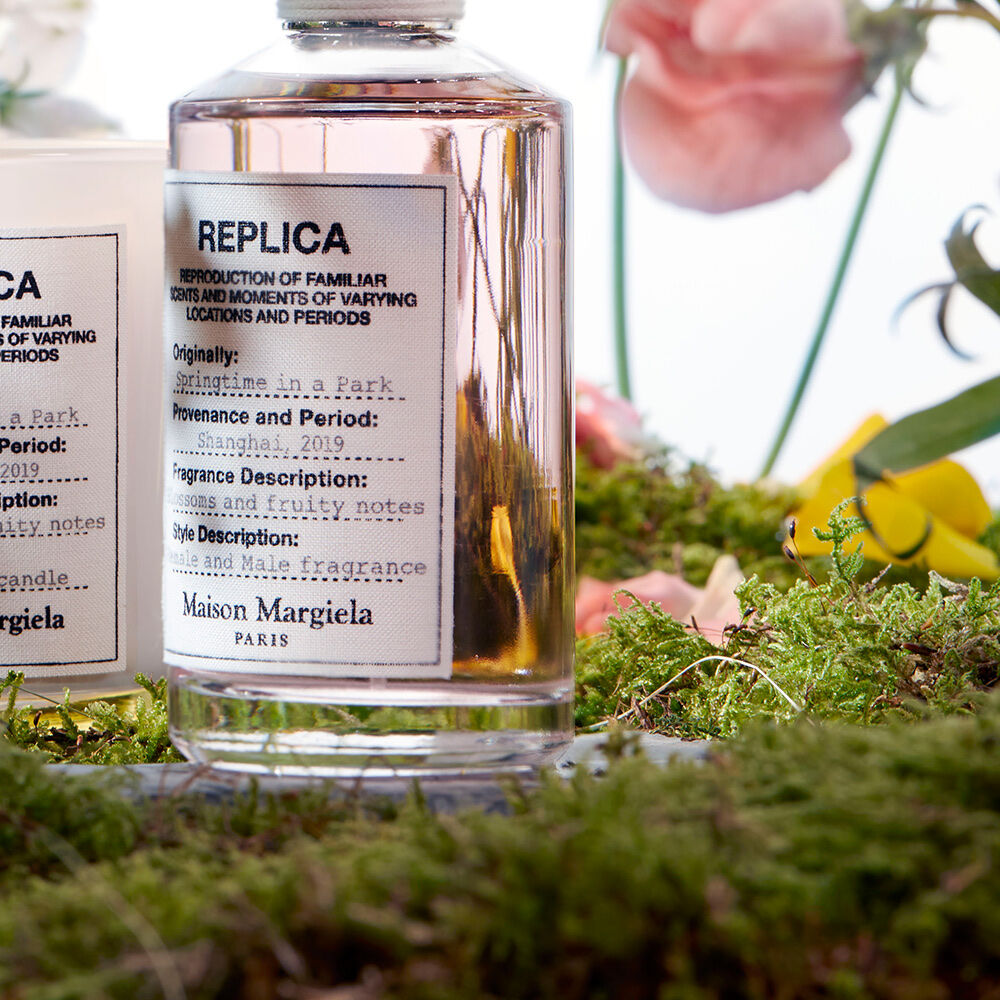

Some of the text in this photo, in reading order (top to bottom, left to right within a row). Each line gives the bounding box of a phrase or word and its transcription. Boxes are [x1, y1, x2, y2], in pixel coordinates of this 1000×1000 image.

[198, 220, 351, 255] REPLICA
[179, 268, 387, 288] REPRODUCTION OF FAMILIAR
[170, 286, 417, 307] SCENTS AND MOMENTS OF VARYING
[1, 314, 72, 329] FAMILIAR
[186, 305, 371, 326] LOCATIONS AND PERIODS
[7, 332, 29, 346] OF
[31, 330, 97, 345] VARYING
[173, 343, 238, 367] Originally:
[176, 370, 393, 393] Springtime in a Park
[10, 412, 21, 425] a
[32, 407, 80, 424] Park
[172, 402, 378, 428] Provenance and Period:
[198, 432, 345, 455] Shanghai, 2019
[0, 462, 40, 479] 2019
[172, 462, 368, 490] Fragrance Description:
[223, 494, 257, 511] and
[266, 496, 345, 518] fruity
[356, 498, 425, 515] notes
[50, 515, 106, 532] notes
[172, 522, 299, 549] Style Description:
[204, 552, 234, 570] and
[242, 554, 290, 573] Male
[300, 555, 427, 578] fragrance
[182, 591, 374, 630] Maison Margiela
[235, 632, 288, 647] PARIS
